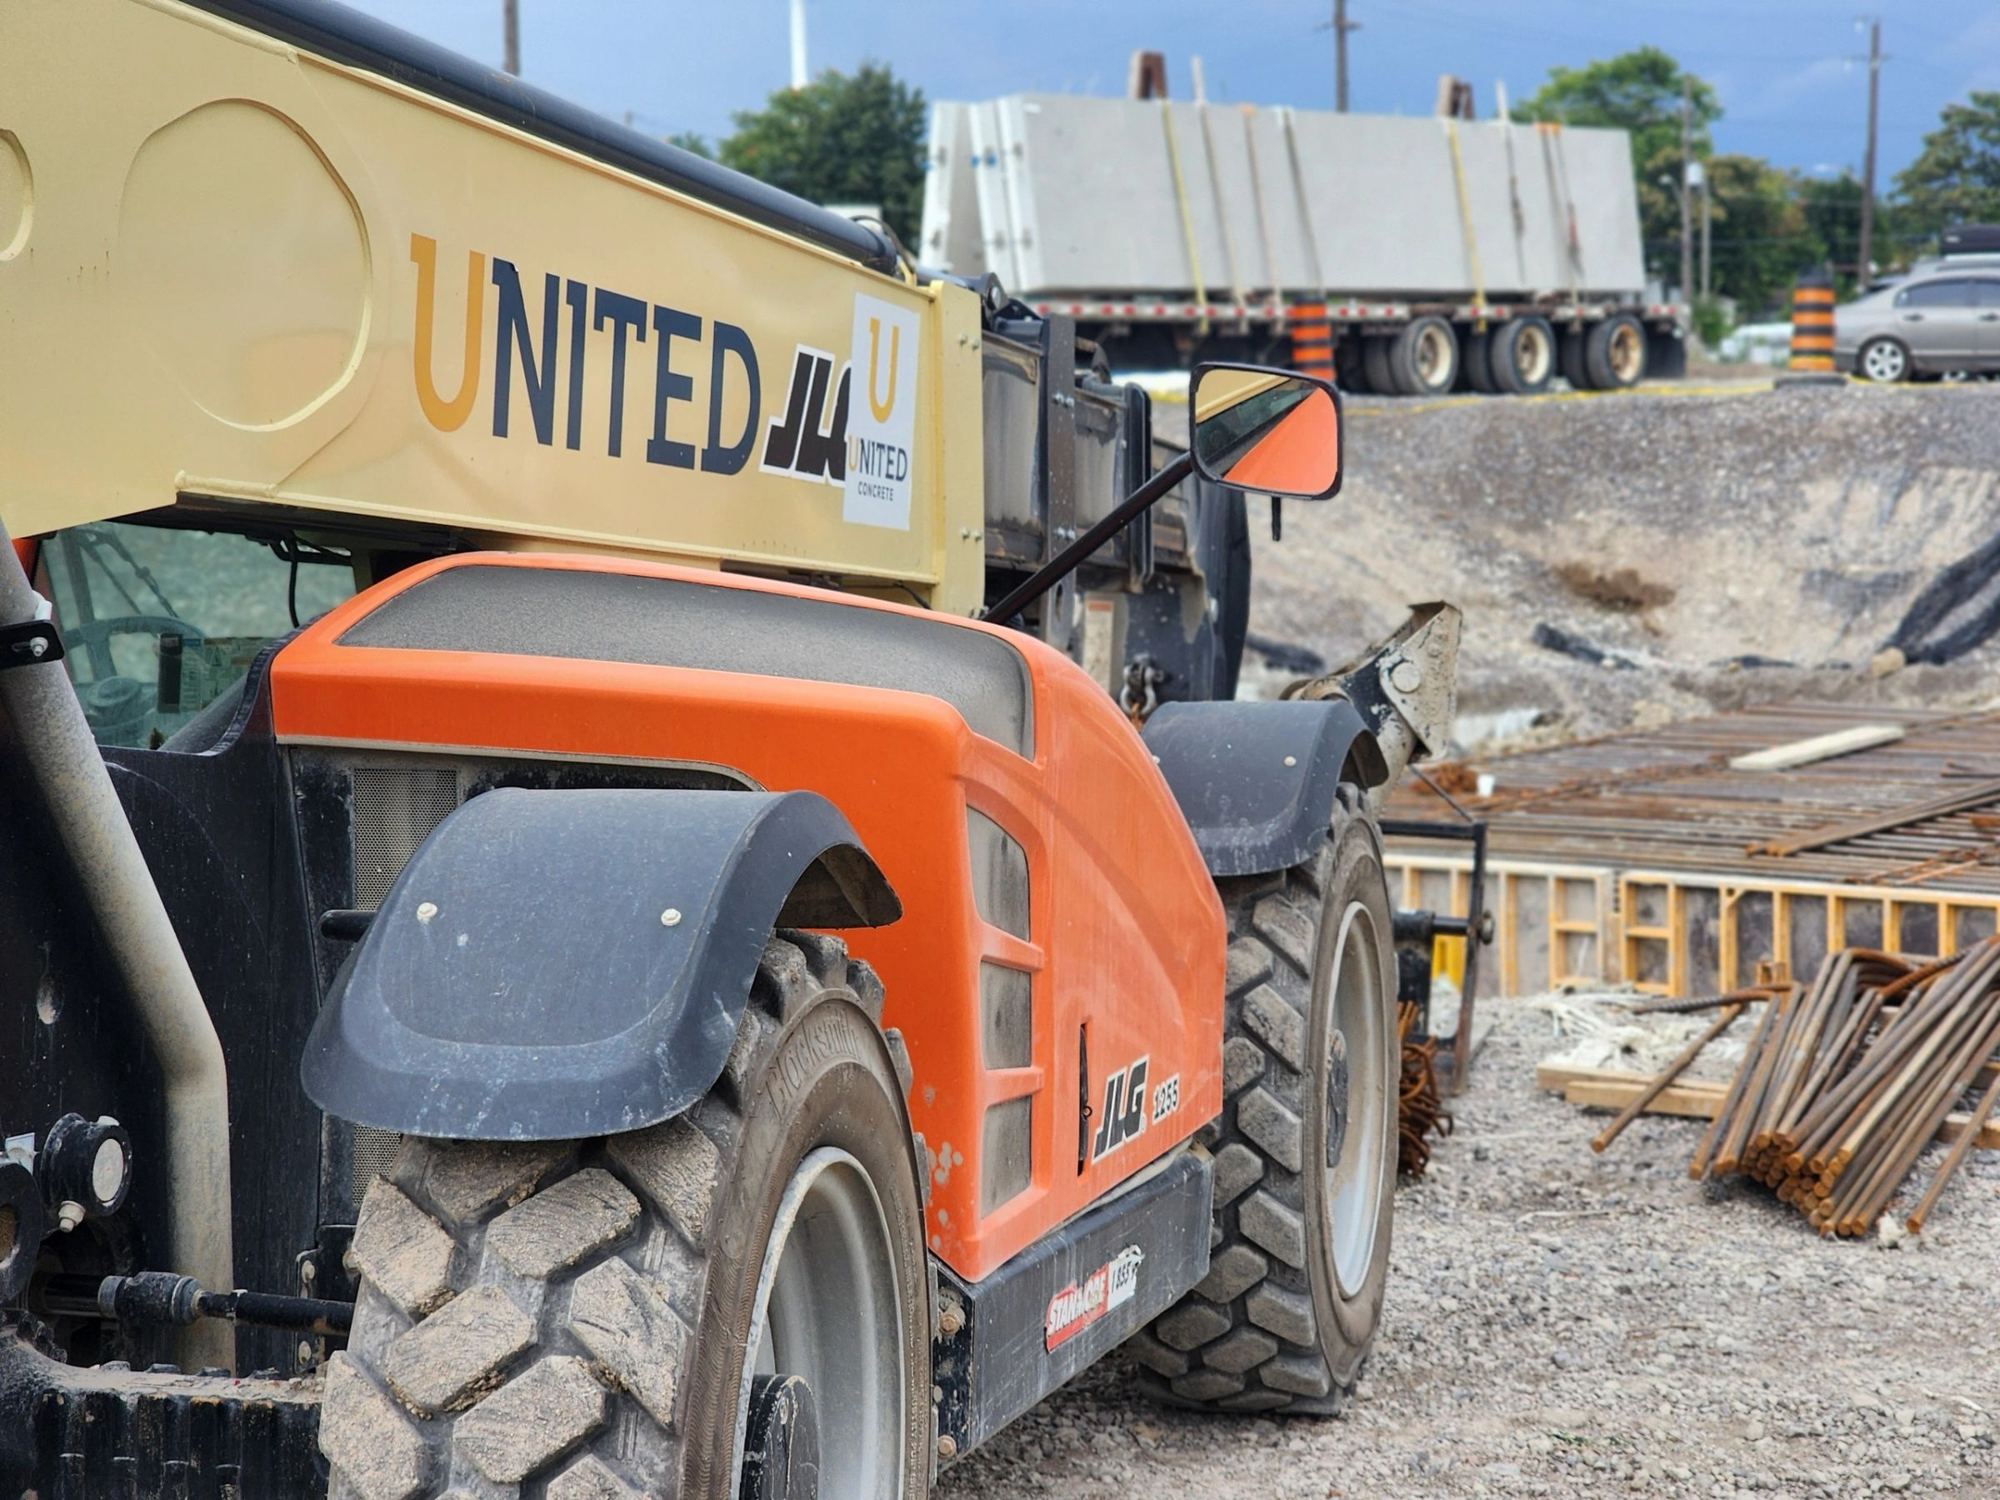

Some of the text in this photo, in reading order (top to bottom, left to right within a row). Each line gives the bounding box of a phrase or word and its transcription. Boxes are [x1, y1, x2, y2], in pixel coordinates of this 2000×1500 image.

[410, 233, 762, 476] UNITED
[848, 435, 908, 483] UNITED
[858, 481, 895, 502] CONCRETE
[1092, 1058, 1179, 1161] JLG 1255
